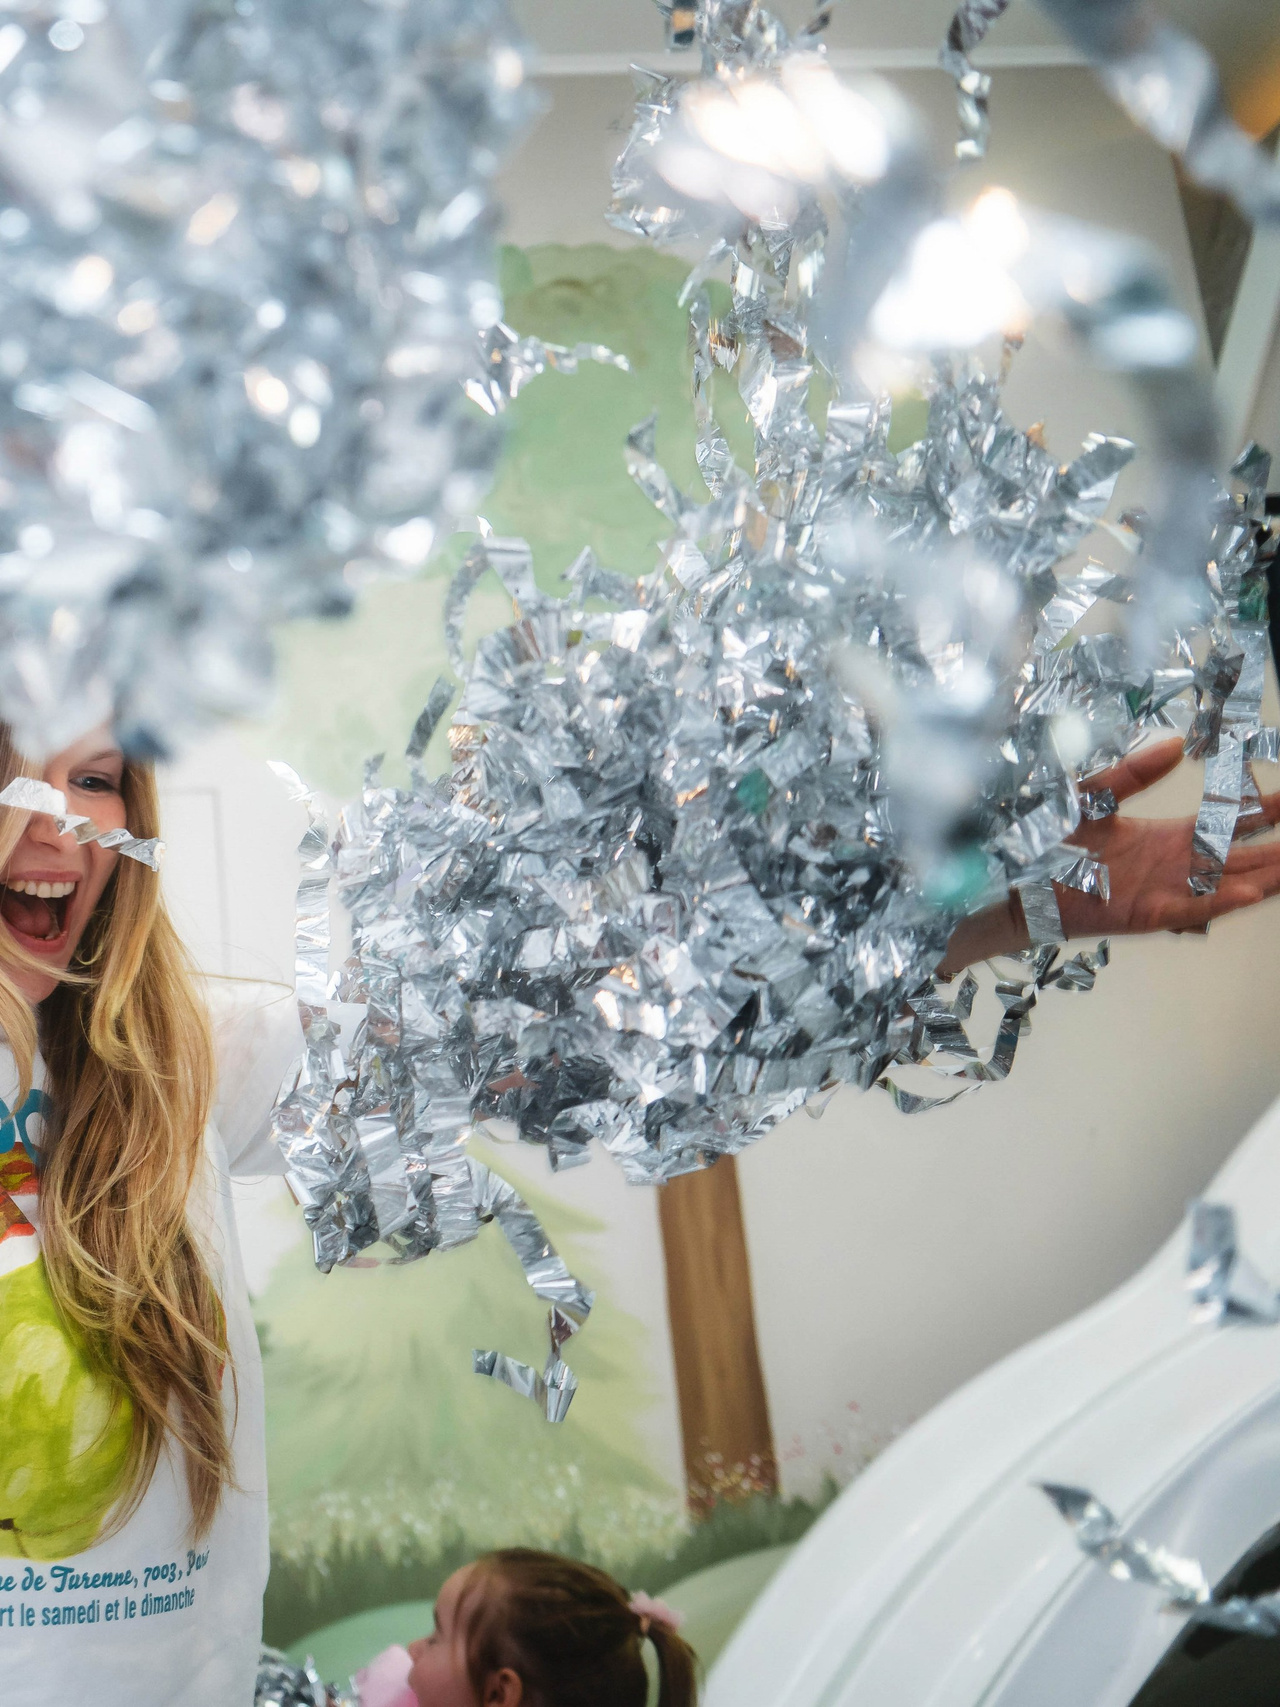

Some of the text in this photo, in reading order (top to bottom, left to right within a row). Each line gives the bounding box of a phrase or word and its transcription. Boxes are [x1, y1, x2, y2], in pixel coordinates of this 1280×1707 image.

[21, 1566, 47, 1592] de
[50, 1565, 138, 1593] Turenne,
[143, 1562, 183, 1588] 7003,
[20, 1602, 36, 1627] le
[41, 1599, 100, 1626] samedi
[104, 1599, 120, 1622] et
[124, 1596, 137, 1620] le
[140, 1585, 196, 1617] dimanche
